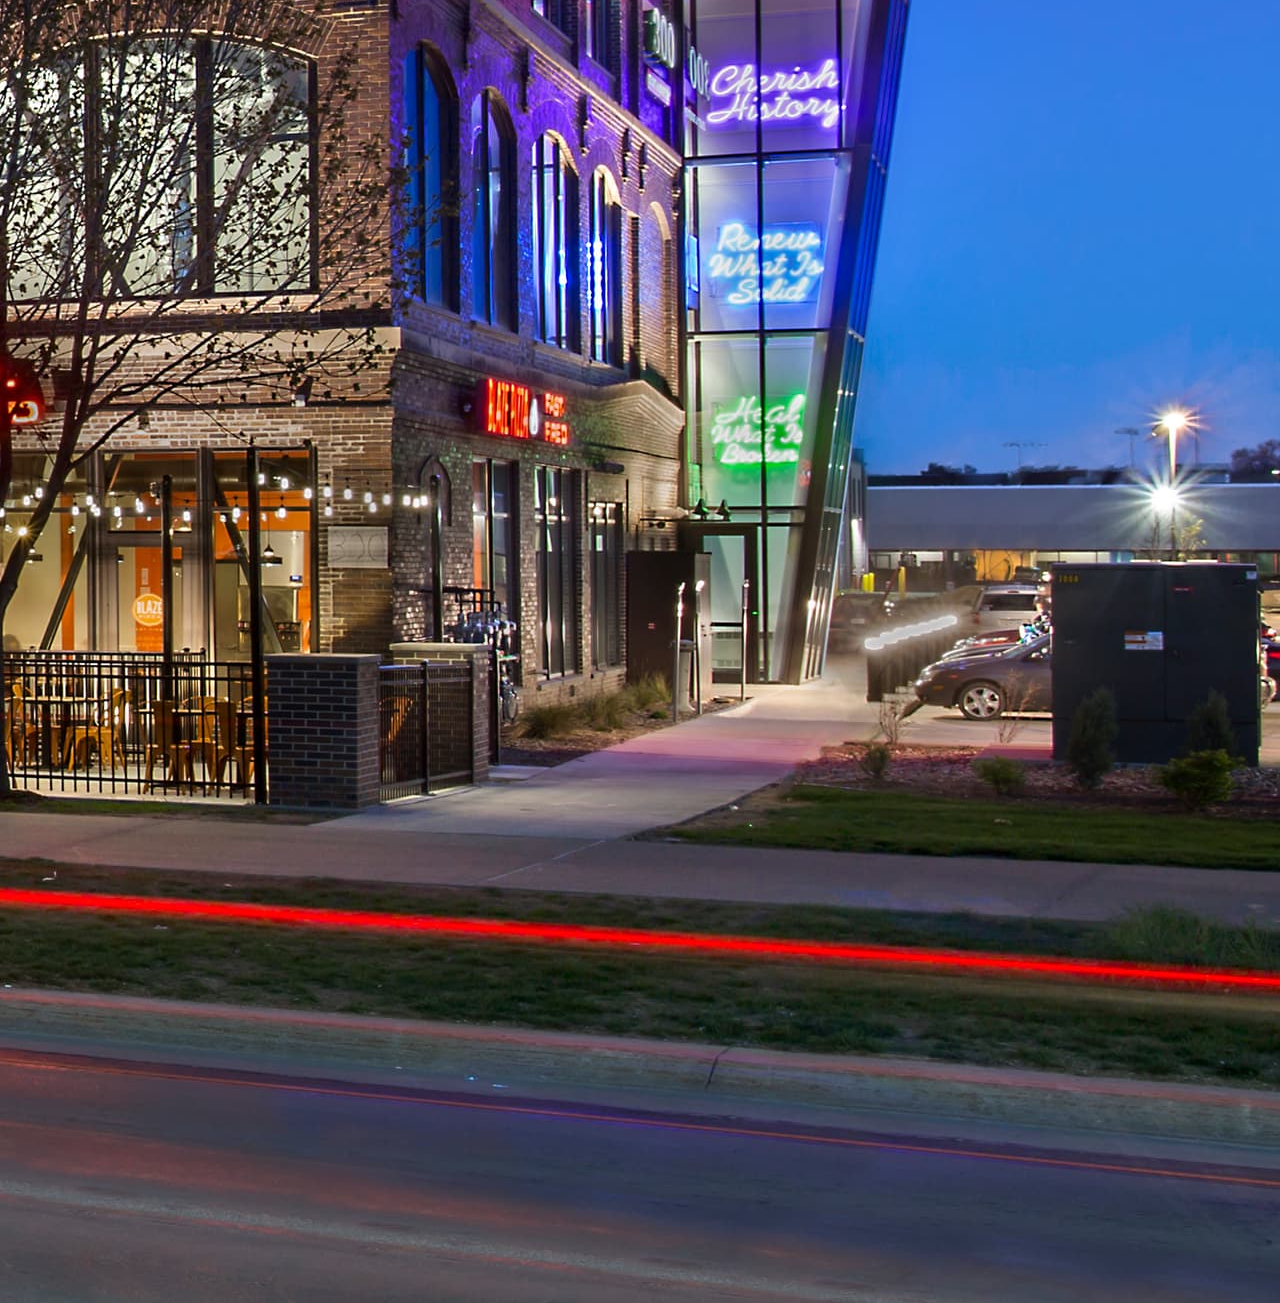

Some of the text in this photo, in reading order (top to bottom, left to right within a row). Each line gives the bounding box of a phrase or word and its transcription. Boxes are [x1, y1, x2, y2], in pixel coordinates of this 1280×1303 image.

[710, 58, 840, 97] Cherish
[706, 92, 847, 129] History
[718, 222, 821, 252] Renew
[709, 250, 825, 278] What Is
[727, 275, 810, 304] Solid
[715, 393, 806, 425] Heal
[711, 423, 776, 445] What
[719, 442, 800, 464] Broken
